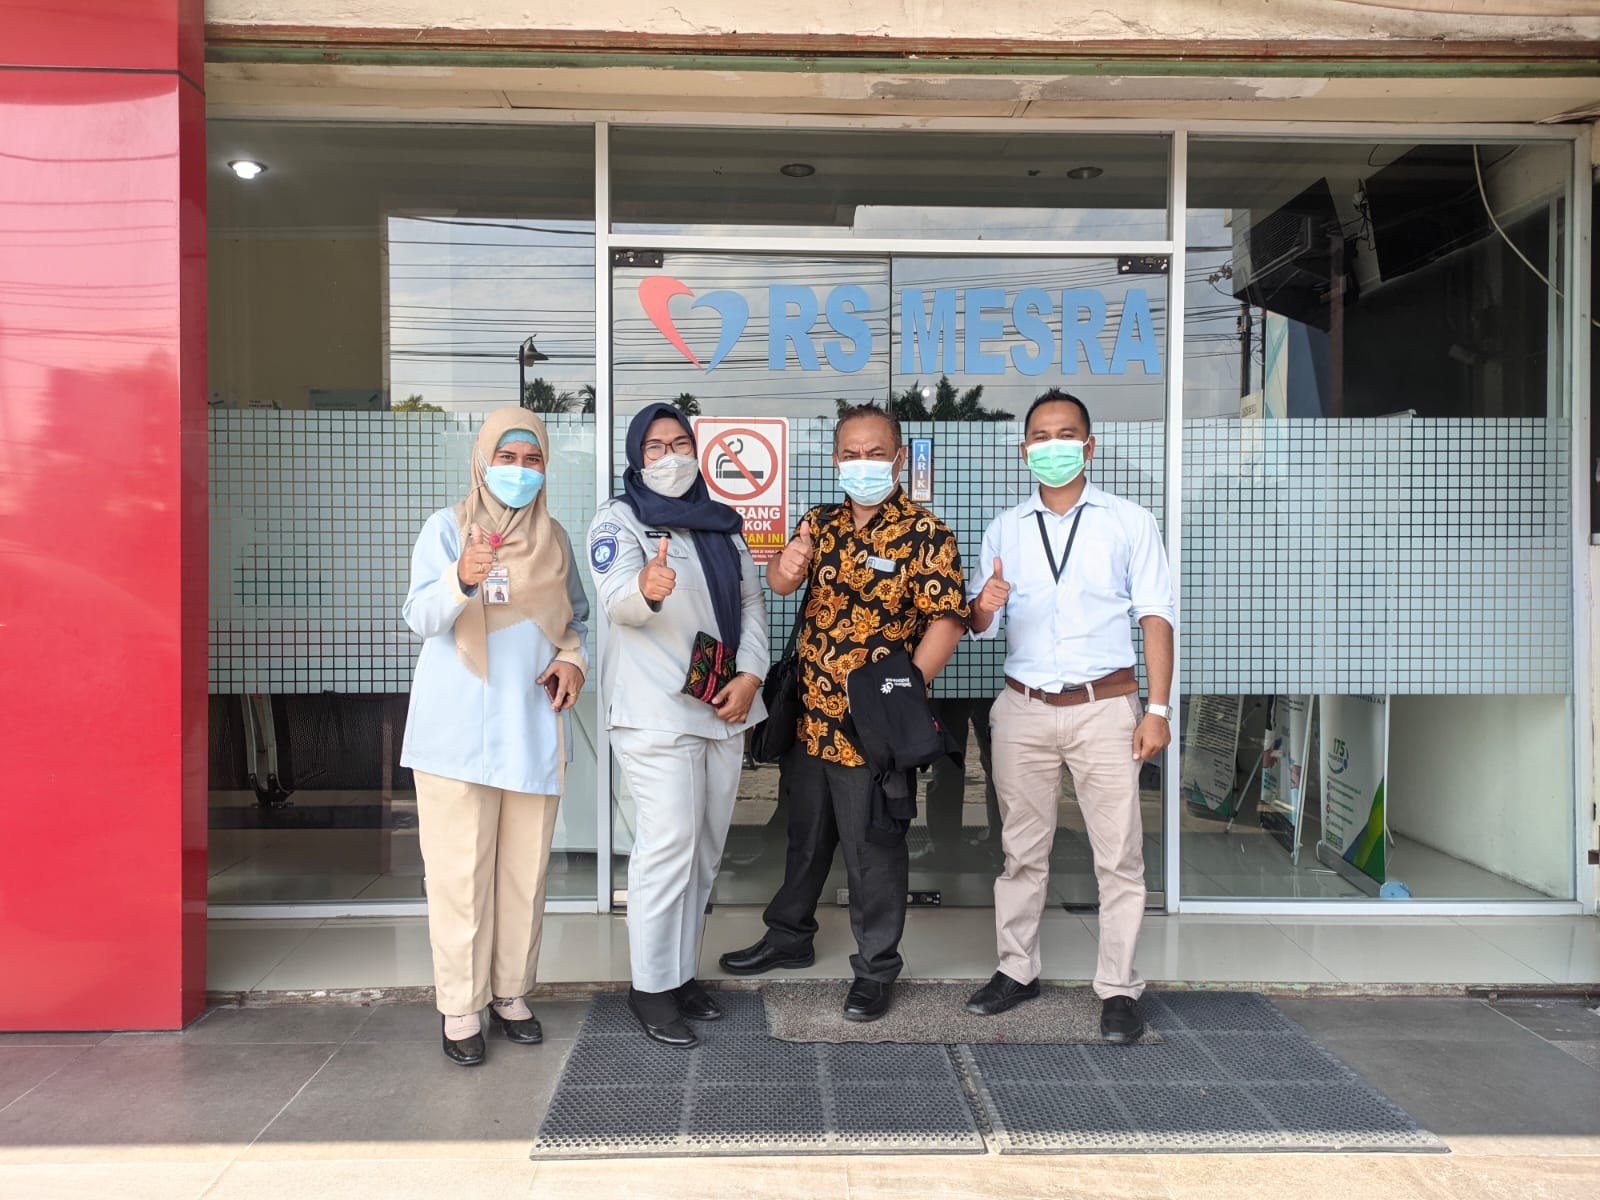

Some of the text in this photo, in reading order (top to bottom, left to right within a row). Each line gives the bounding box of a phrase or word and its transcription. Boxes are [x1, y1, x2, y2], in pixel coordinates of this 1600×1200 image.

[767, 284, 1162, 376] RS MESRA
[917, 443, 926, 488] TARIK
[736, 507, 780, 519] RANG
[744, 521, 772, 530] KOK
[768, 533, 784, 543] INI
[1333, 737, 1346, 757] 175
